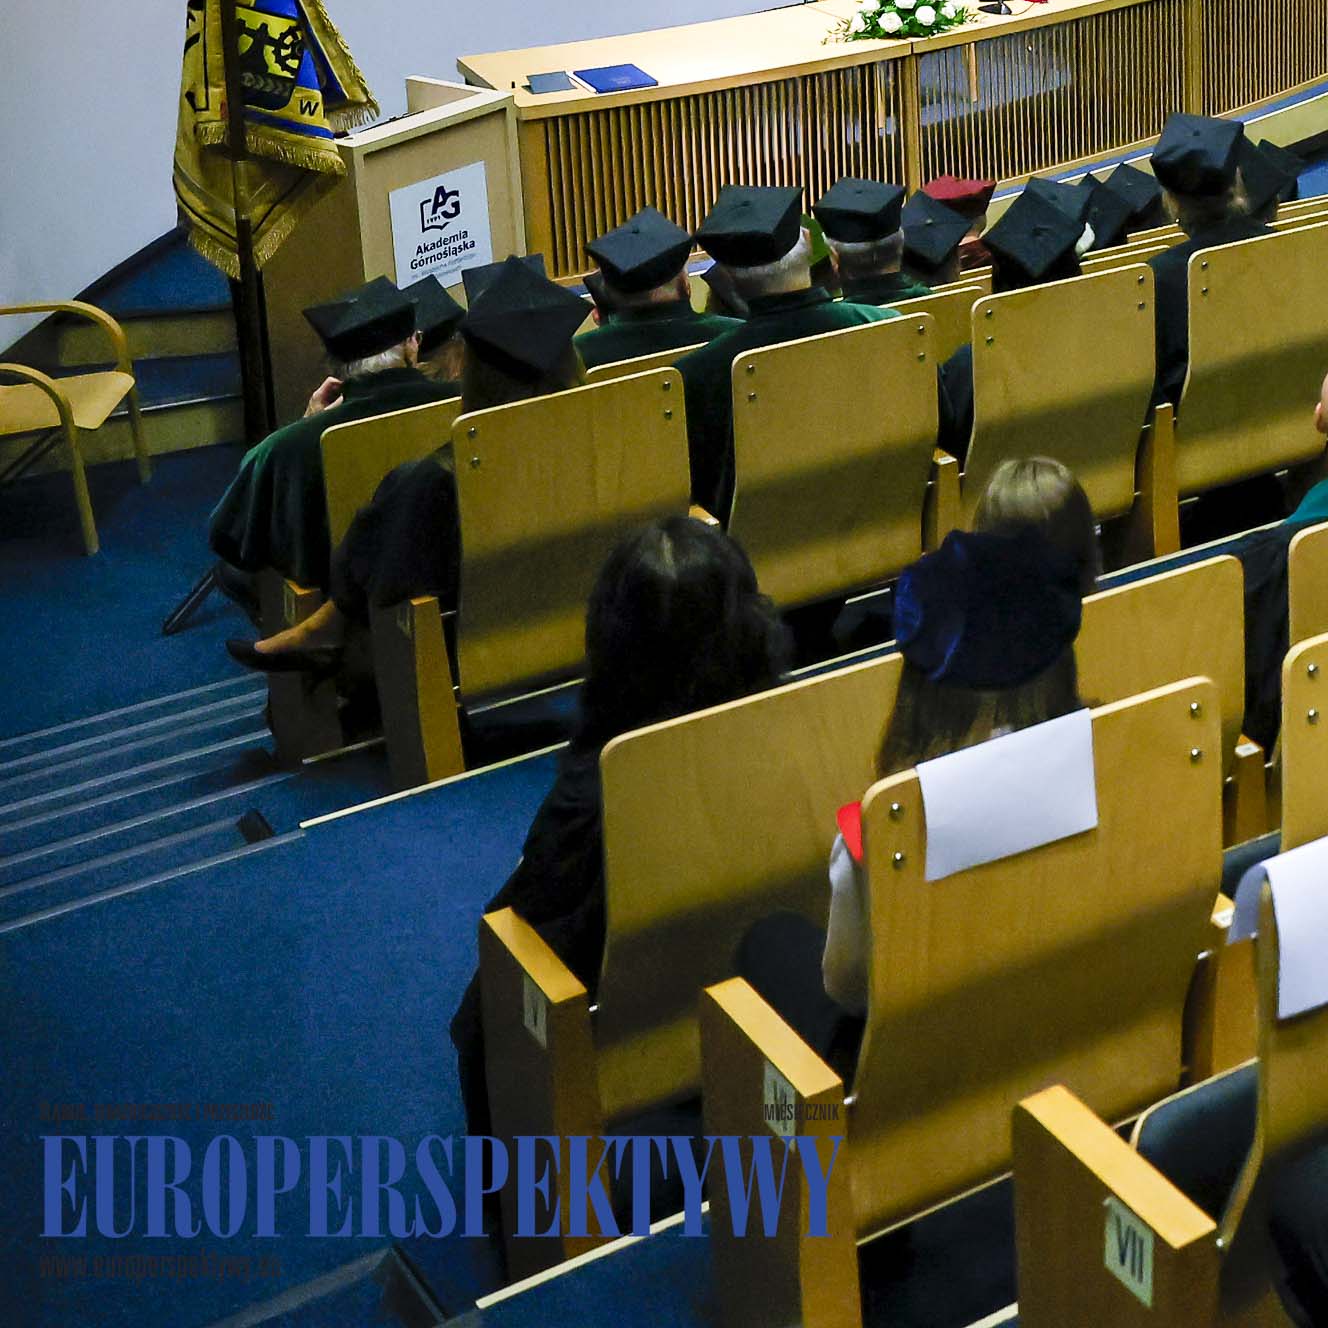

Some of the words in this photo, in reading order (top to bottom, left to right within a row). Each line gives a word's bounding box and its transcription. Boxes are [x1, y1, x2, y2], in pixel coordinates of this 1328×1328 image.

[431, 185, 461, 220] AG
[410, 240, 476, 270] Górnośląska
[415, 230, 469, 257] Akademia
[1115, 1213, 1144, 1285] VII
